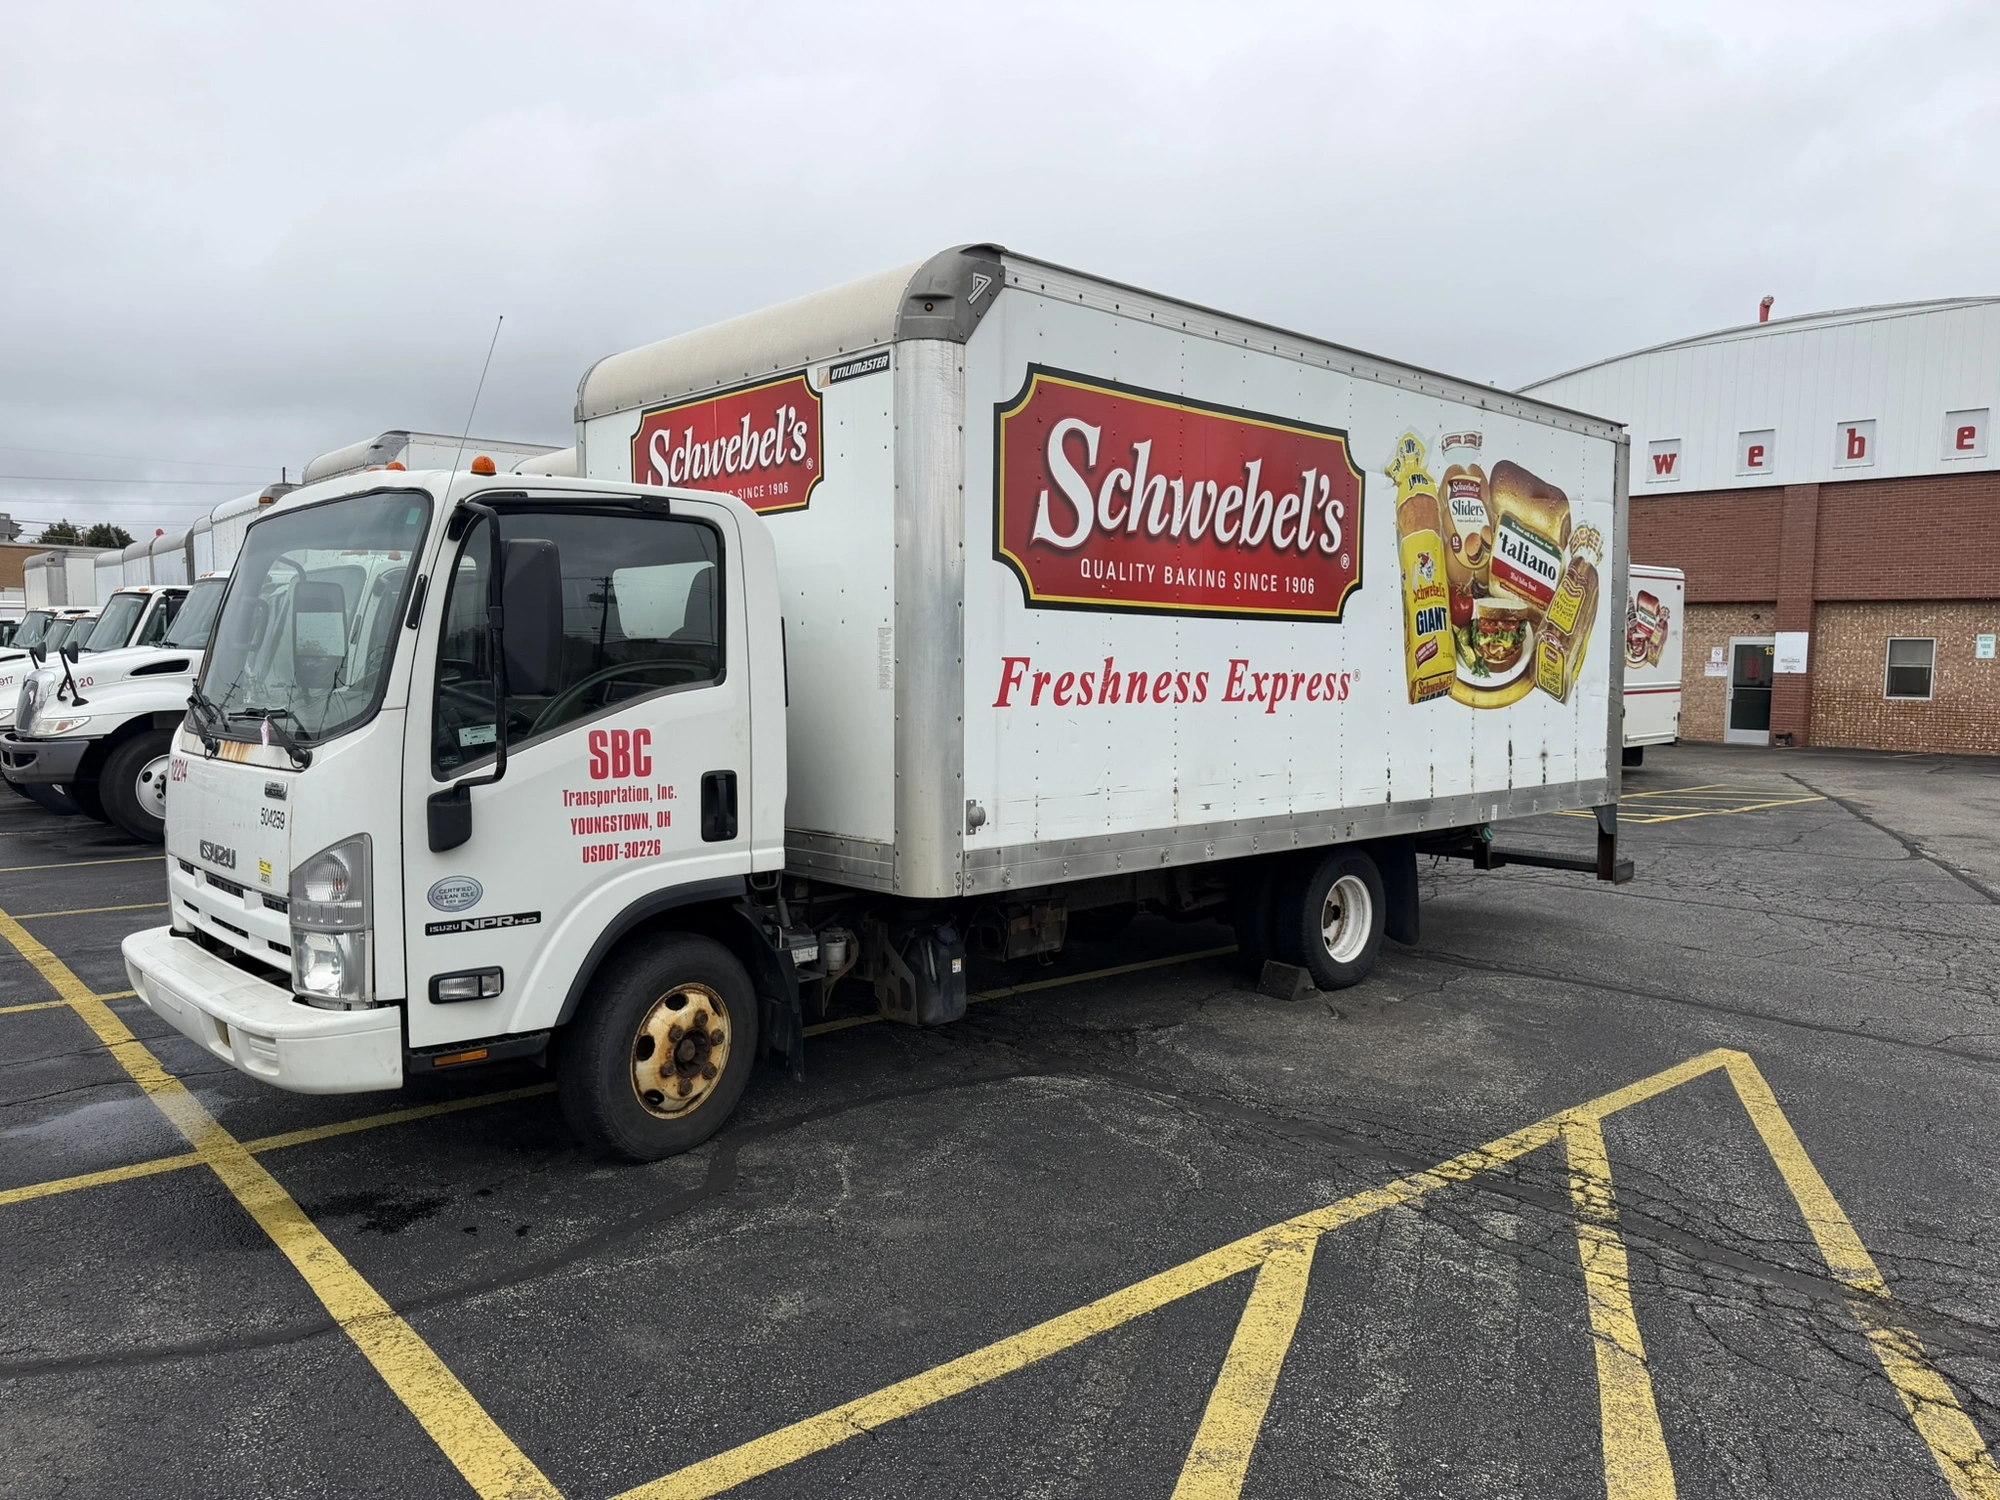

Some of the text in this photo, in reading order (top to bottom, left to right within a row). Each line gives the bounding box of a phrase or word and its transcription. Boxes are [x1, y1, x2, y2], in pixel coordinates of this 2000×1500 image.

[647, 404, 808, 487] Schwebel's
[737, 481, 789, 500] SINCE 1906
[1030, 417, 1345, 553] Schwebel's
[1452, 500, 1484, 516] Sliders
[1080, 558, 1315, 595] QUALITY BAKING SINCE 1906
[1416, 607, 1447, 636] GIANT
[992, 656, 1351, 714] Freshness Express
[588, 728, 652, 780] SBC
[562, 783, 678, 808] Transportation, Inc.
[260, 807, 285, 830] 504259
[570, 810, 671, 836] YOUNGSTOWN, OH
[200, 839, 236, 870] ISUZU
[582, 839, 661, 864] USDOT-30226
[429, 924, 459, 933] ISUZU
[461, 916, 514, 931] NPR
